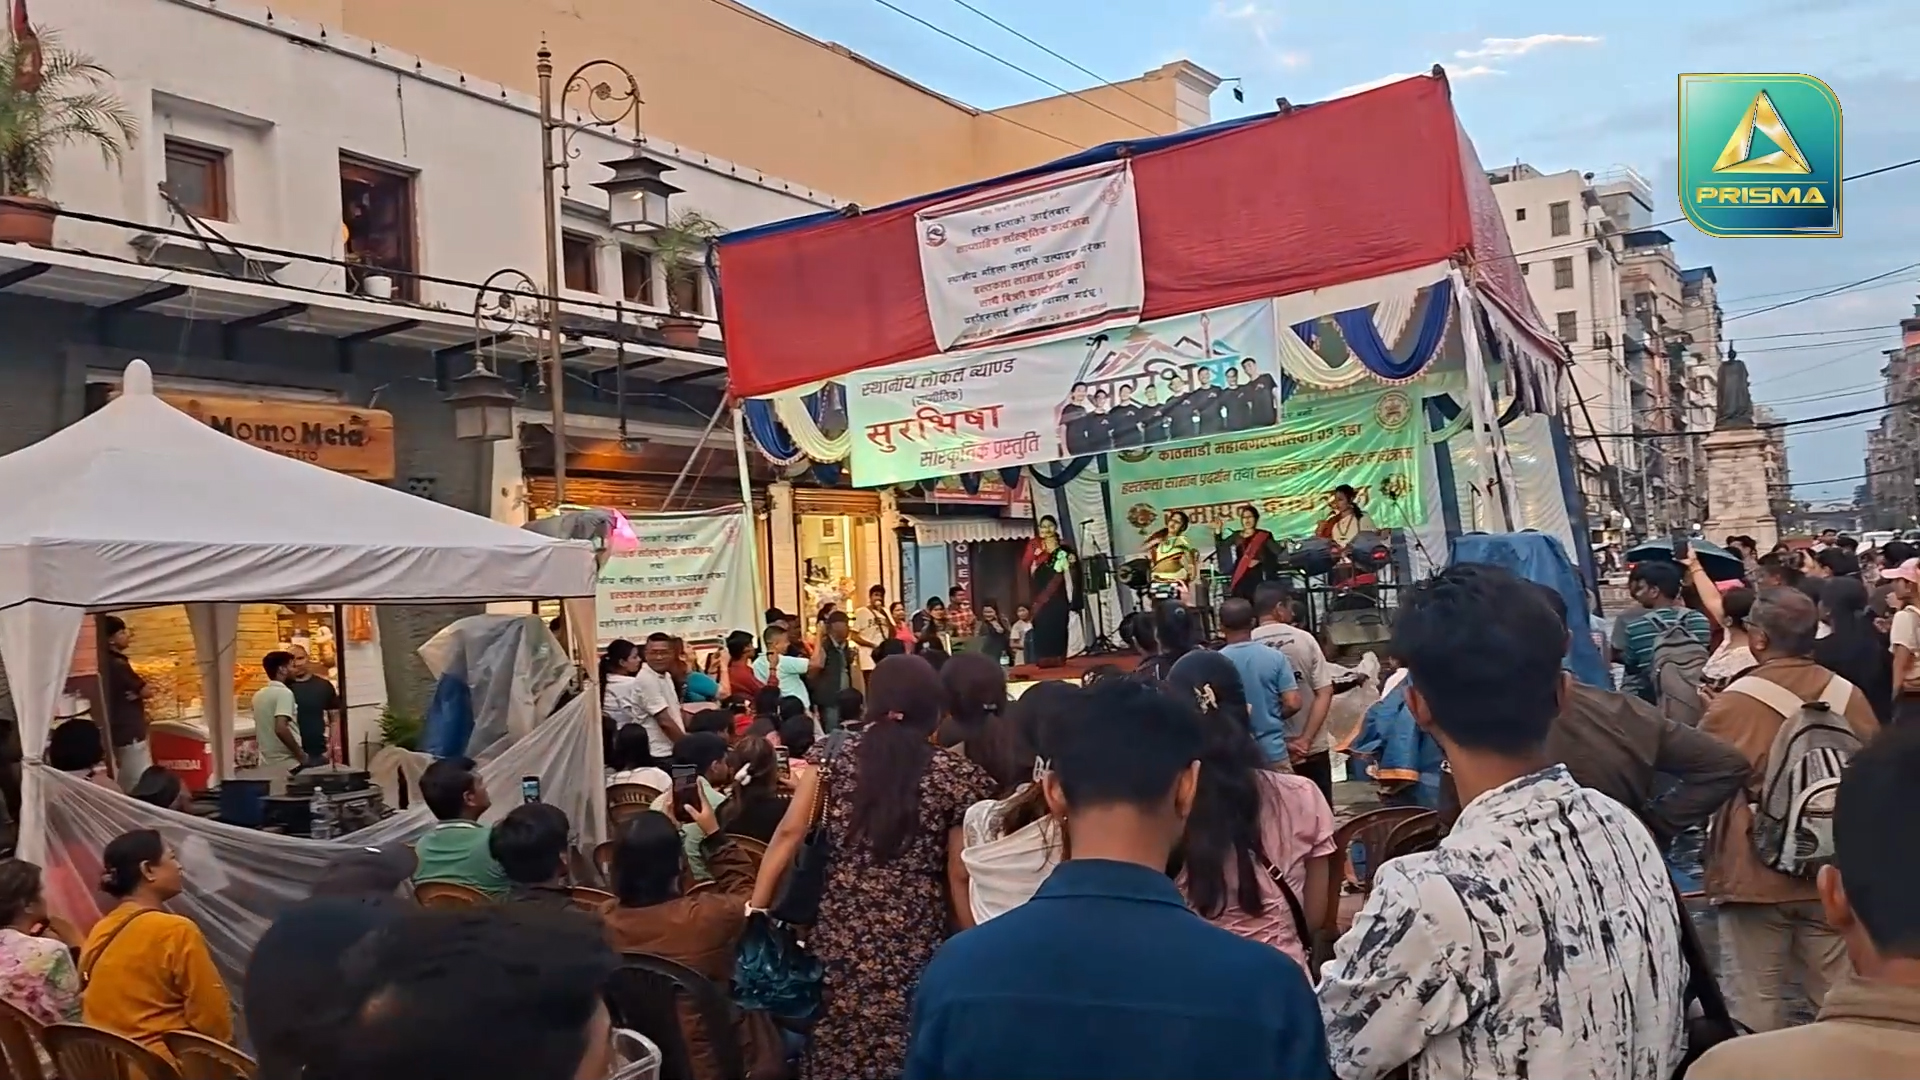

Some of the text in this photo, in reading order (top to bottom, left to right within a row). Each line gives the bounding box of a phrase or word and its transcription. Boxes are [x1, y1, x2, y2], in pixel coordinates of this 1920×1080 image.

[971, 223, 991, 237] हरेक
[981, 262, 1007, 277] महिला
[861, 357, 1017, 397] स्थानीय लोकल ब्याण्ड
[210, 415, 297, 443] Momo
[865, 404, 1004, 454] सुरभिषा
[993, 431, 1041, 460] प्रस्तुति
[1233, 466, 1255, 482] तथा
